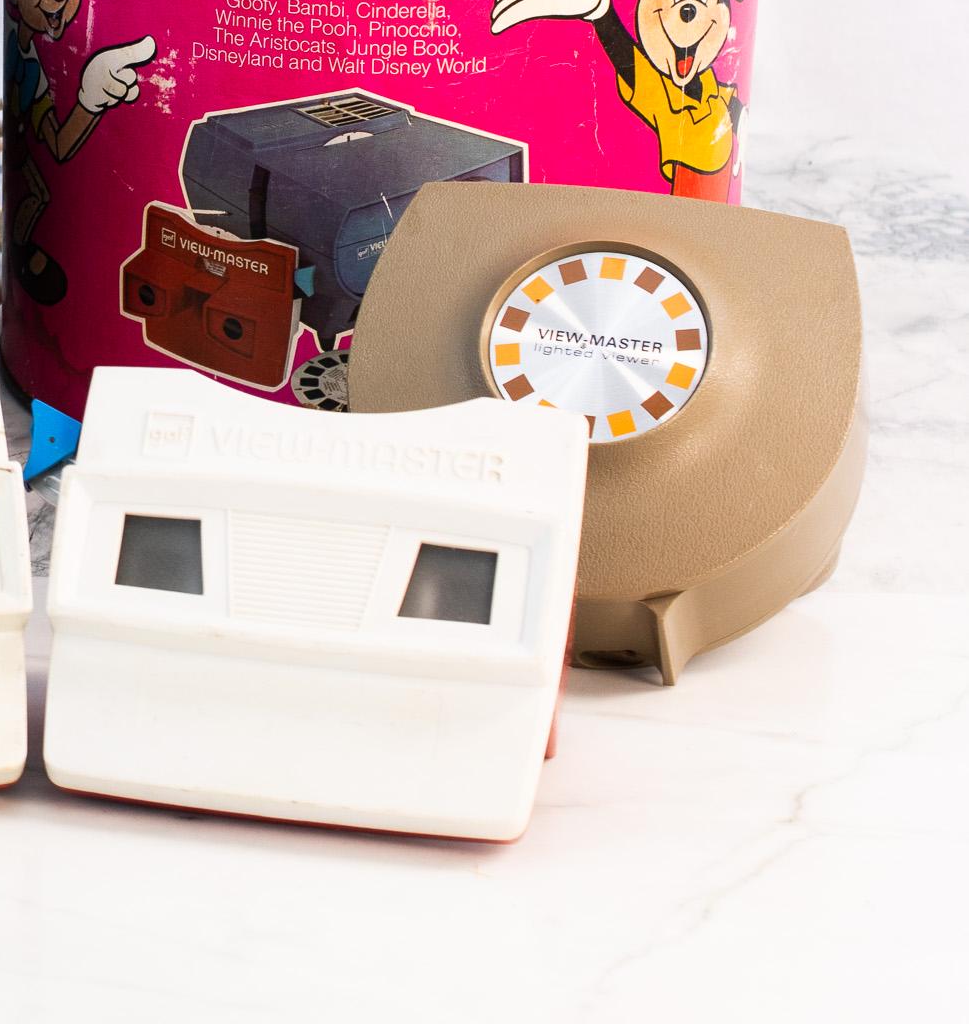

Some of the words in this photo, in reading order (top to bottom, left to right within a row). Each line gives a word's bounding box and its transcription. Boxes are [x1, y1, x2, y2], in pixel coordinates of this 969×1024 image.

[215, 9, 273, 31] Winnie
[277, 17, 305, 34] the
[310, 19, 362, 39] Pooh,
[369, 21, 462, 39] Pinocchio,
[356, 2, 451, 20] Cinderella,
[213, 27, 245, 47] The
[249, 32, 340, 56] Aristocats,
[346, 39, 408, 60] Jungle
[413, 40, 465, 58] Book,
[192, 42, 284, 69] Disneyland
[288, 56, 323, 72] and
[328, 57, 365, 75] Walt
[371, 58, 431, 78] Disney
[436, 56, 487, 75] World
[179, 237, 269, 275] VIEW-MASTER
[533, 342, 593, 359] lighted
[601, 350, 660, 367] viewer
[538, 328, 663, 353] VIEW-MASTER
[207, 418, 505, 484] VIEW-MASTER
